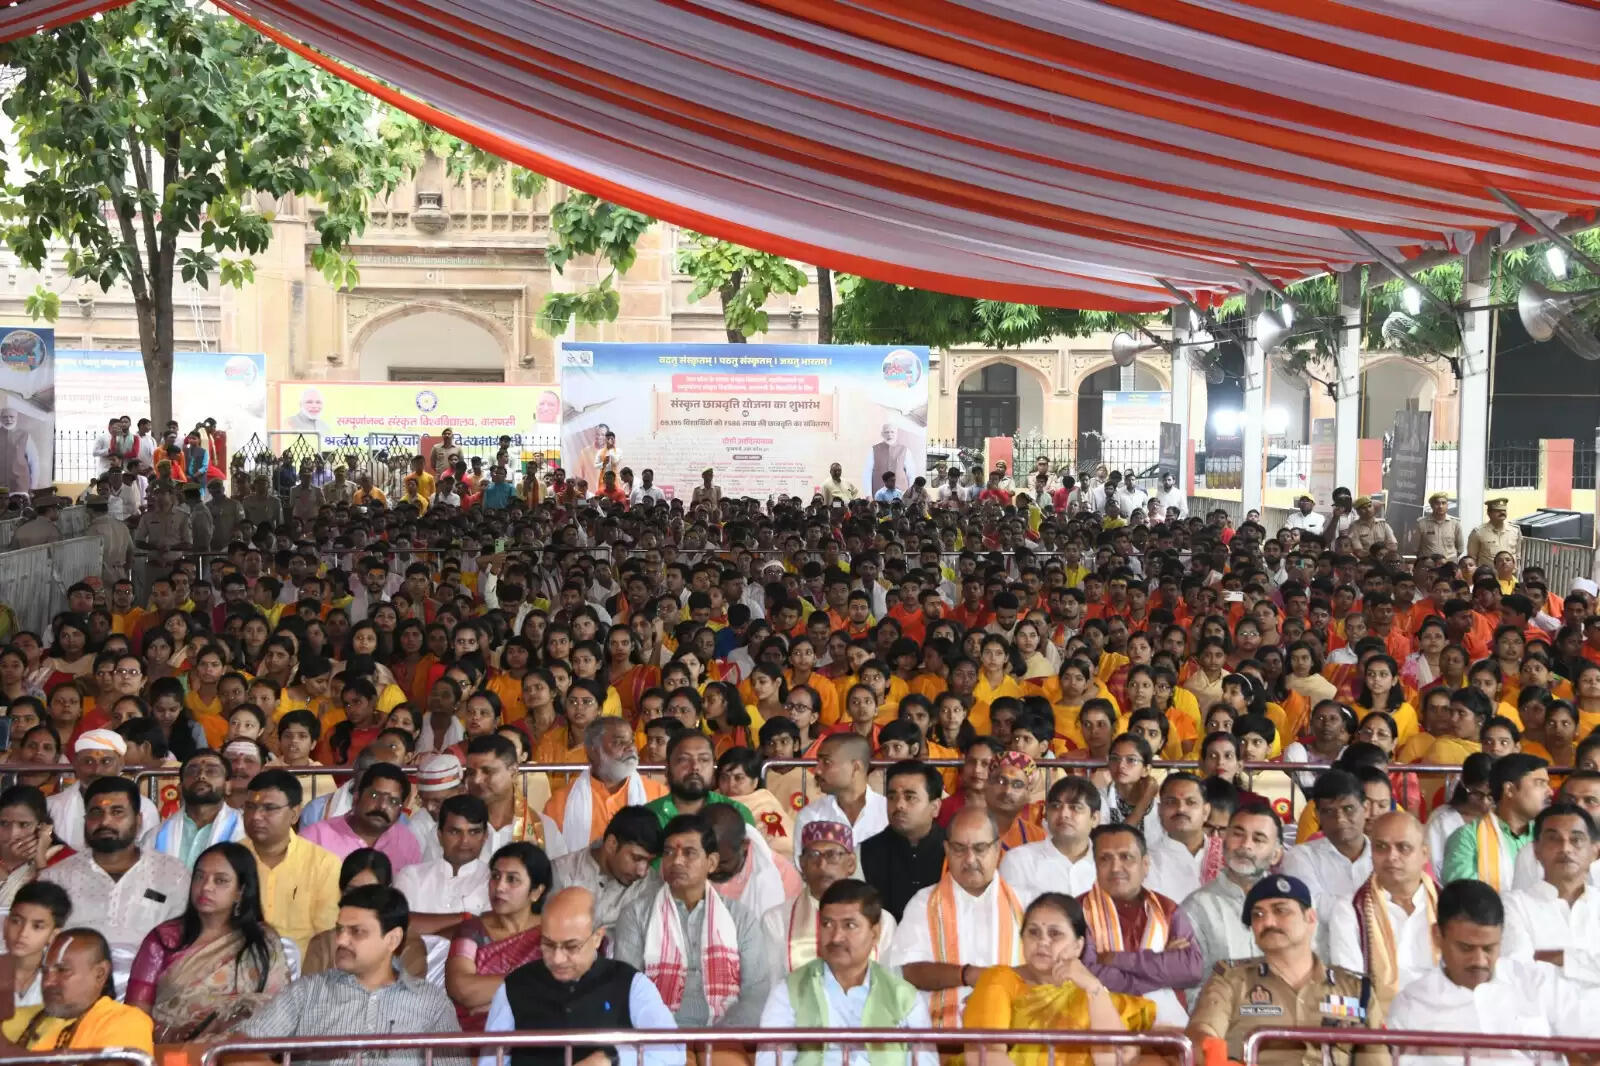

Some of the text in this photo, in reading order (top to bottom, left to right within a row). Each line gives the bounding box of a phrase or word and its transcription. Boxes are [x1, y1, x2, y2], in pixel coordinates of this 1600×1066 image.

[679, 355, 713, 367] संस्कृतम्
[740, 356, 773, 368] संस्कृतम्
[670, 398, 701, 412] संस्कृत
[702, 398, 740, 412] छात्रवृत्ति
[742, 398, 771, 409] योजना
[773, 400, 787, 409] का
[789, 399, 821, 413] शुभारंभ
[388, 415, 418, 429] संस्कृत
[480, 414, 516, 426] वाराणसी
